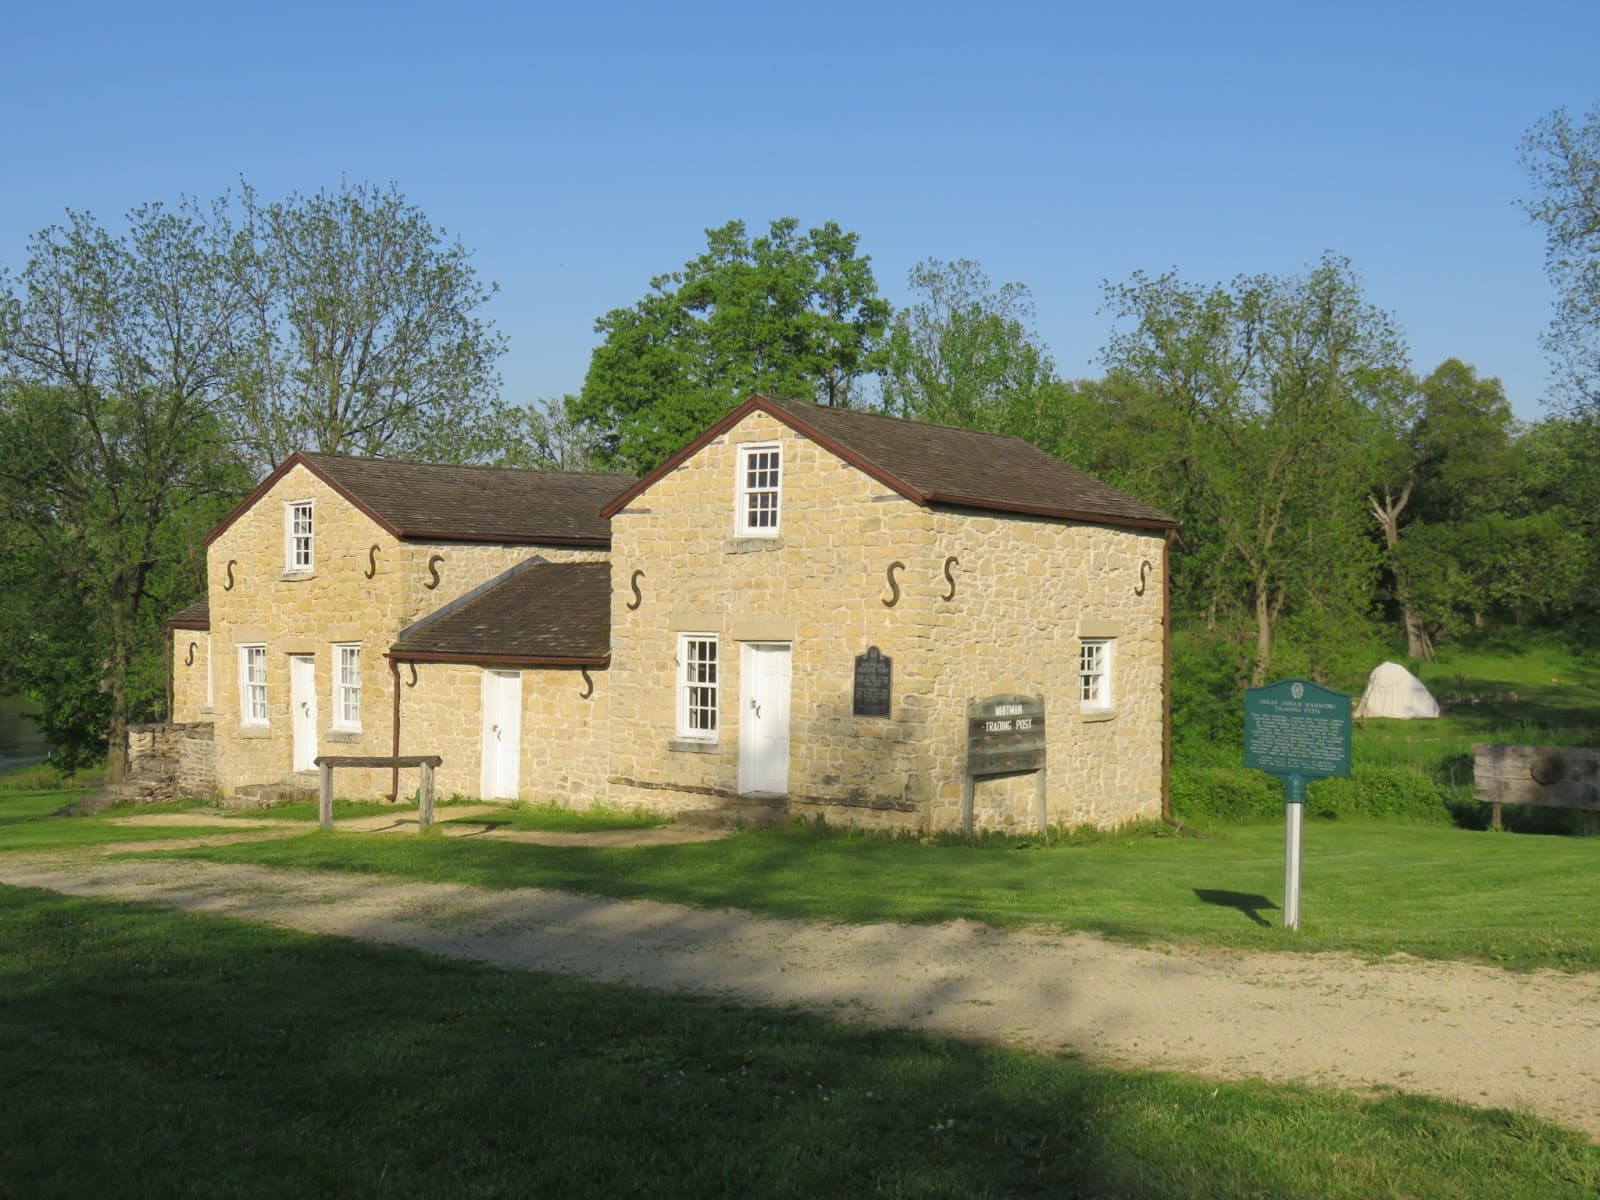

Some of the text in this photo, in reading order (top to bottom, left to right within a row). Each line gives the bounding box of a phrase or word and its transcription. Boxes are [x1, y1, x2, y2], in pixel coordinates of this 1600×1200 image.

[995, 704, 1023, 717] WHITMAN
[985, 718, 1033, 733] TRADING POST
